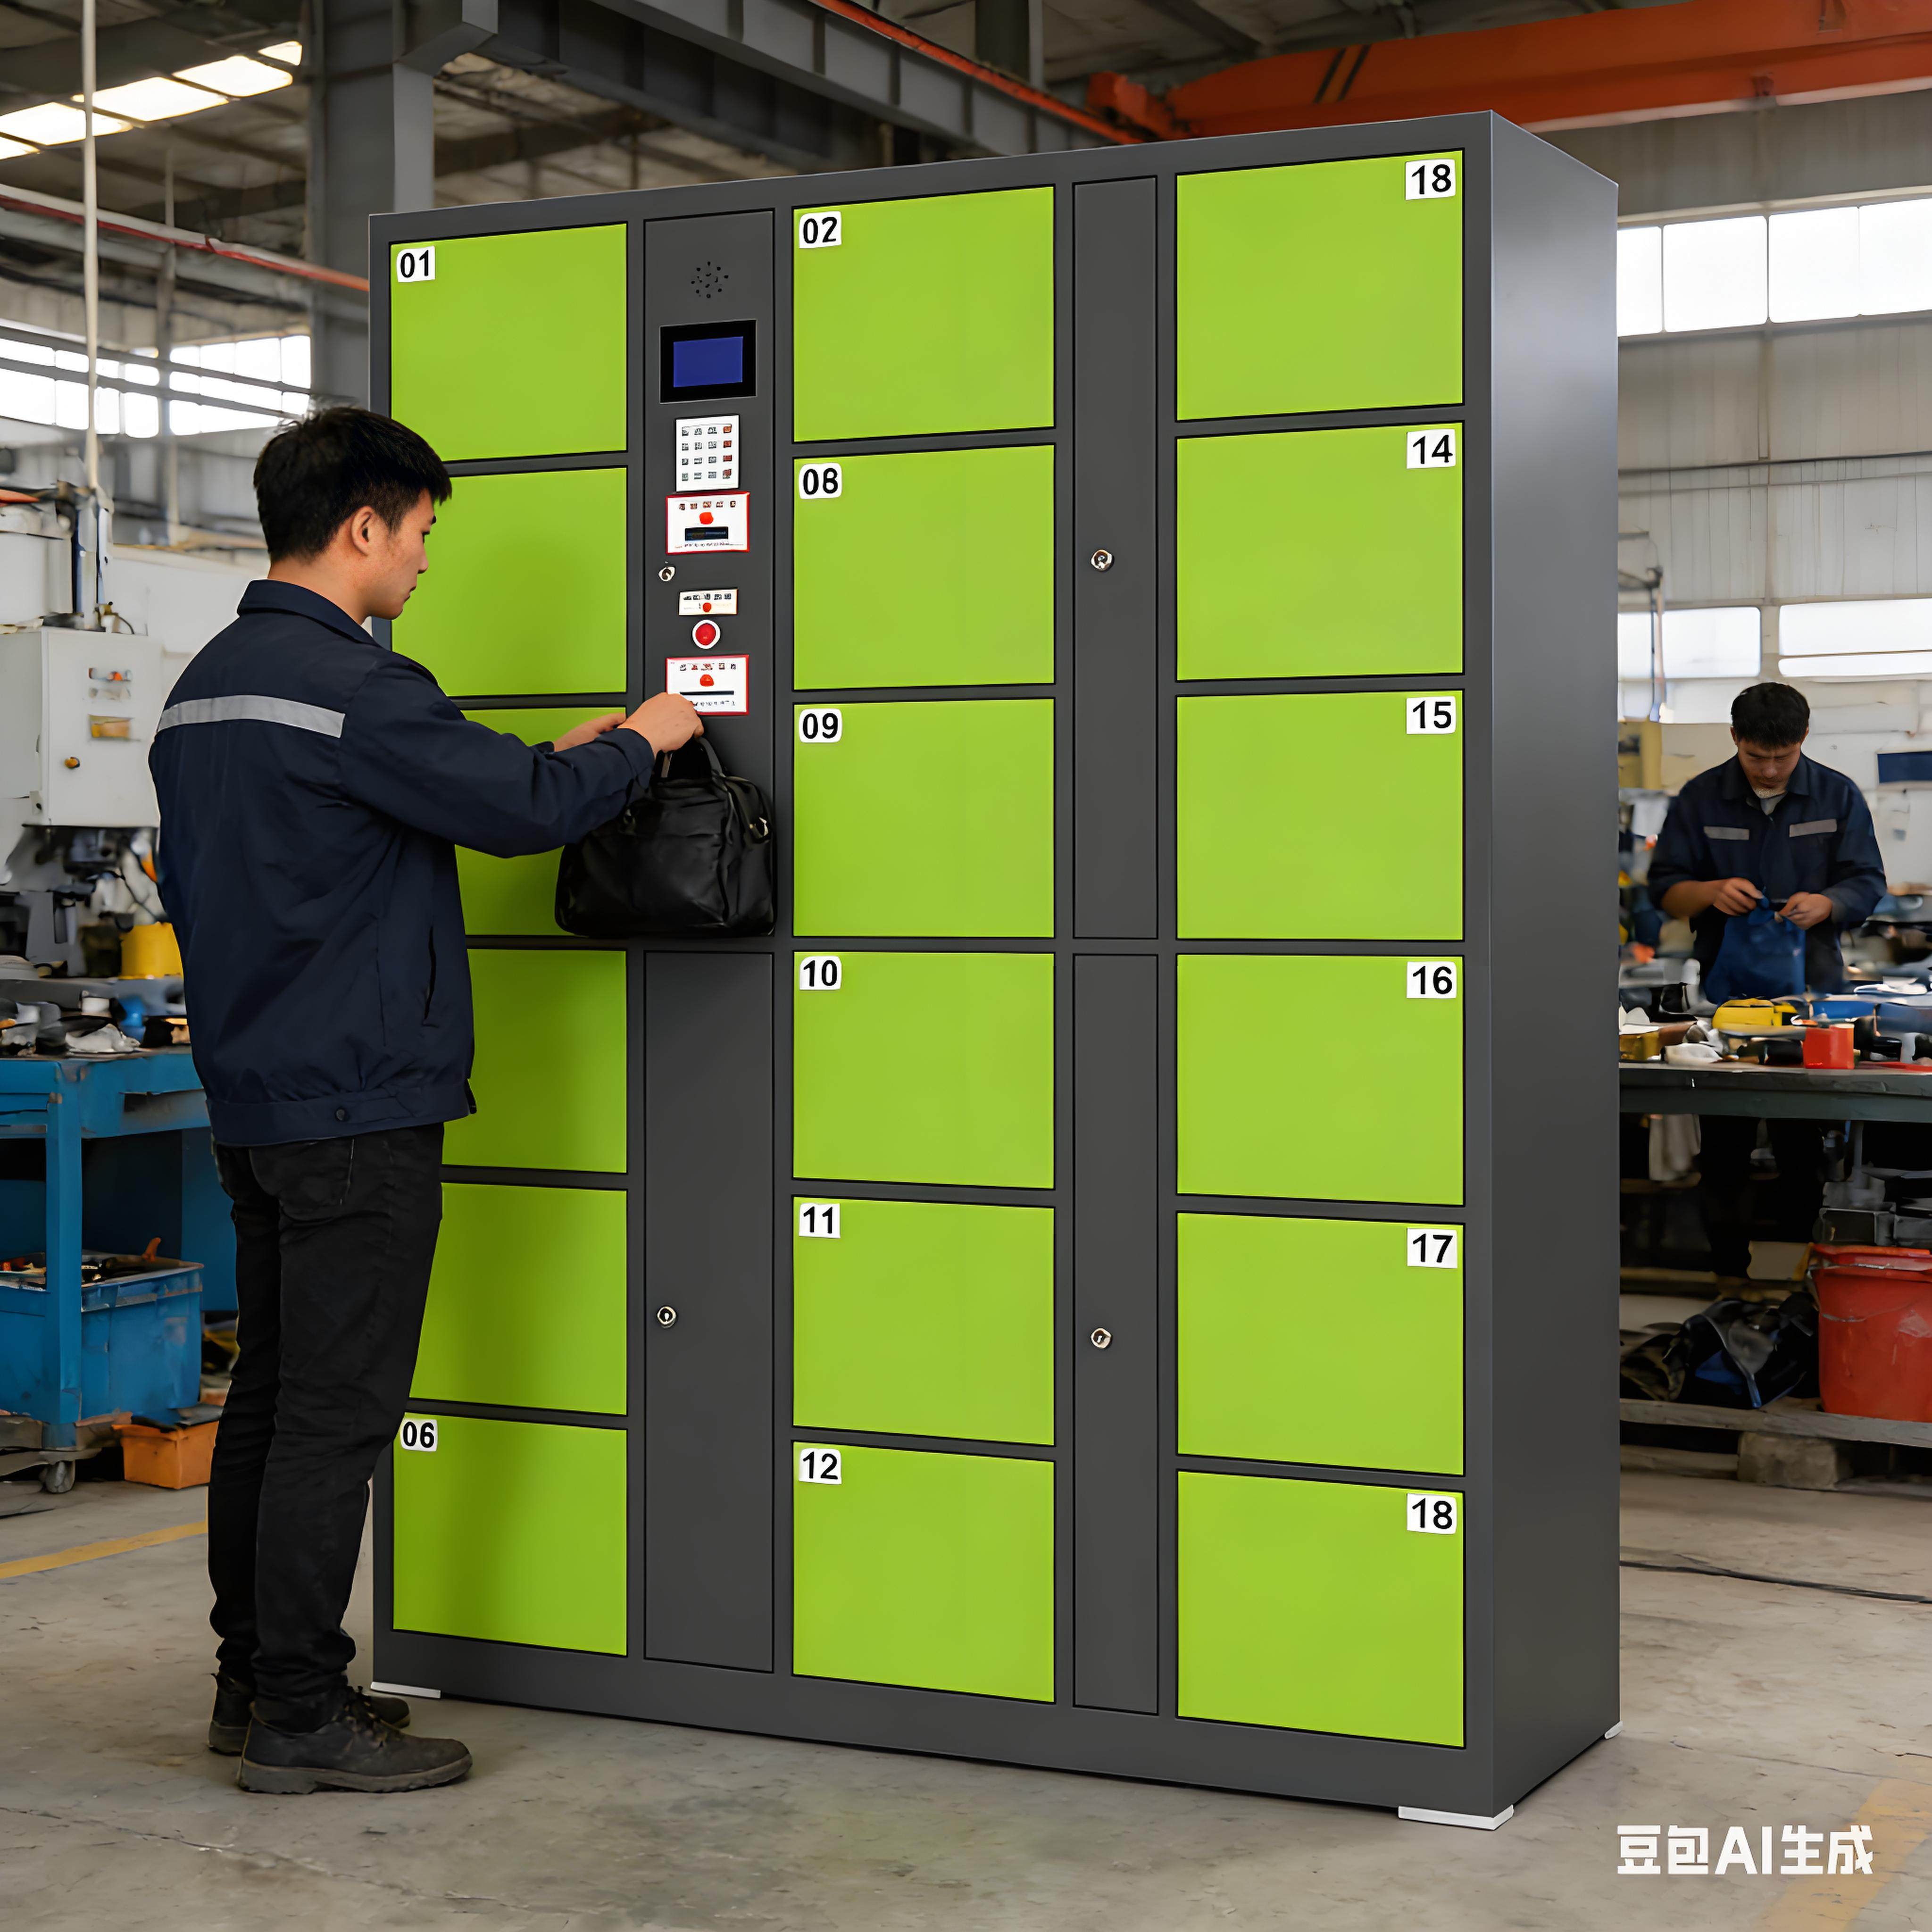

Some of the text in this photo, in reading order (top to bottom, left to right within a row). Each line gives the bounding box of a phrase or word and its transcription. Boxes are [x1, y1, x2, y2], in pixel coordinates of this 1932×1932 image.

[1411, 163, 1452, 195] 18
[802, 217, 838, 244] 02
[400, 250, 430, 279] 01
[1412, 434, 1454, 465] 14
[802, 467, 839, 495] 08
[802, 712, 839, 740] 09
[1412, 700, 1452, 730] 15
[803, 959, 838, 987] 10
[1412, 965, 1453, 995] 16
[803, 1206, 834, 1234] 11
[1412, 1233, 1454, 1264] 17
[401, 1421, 435, 1449] 06
[802, 1451, 839, 1480] 12
[1411, 1497, 1453, 1530] 18
